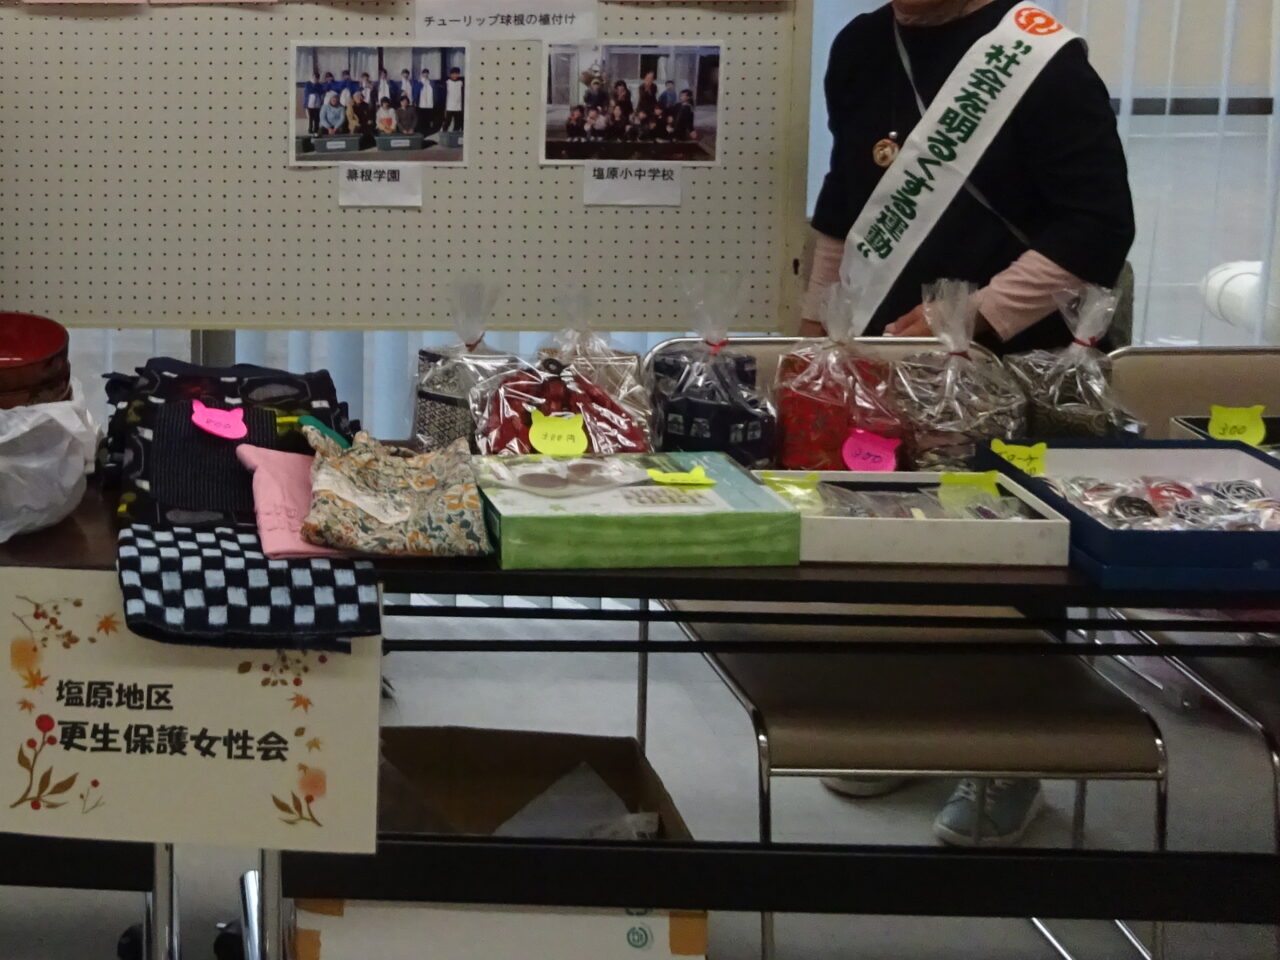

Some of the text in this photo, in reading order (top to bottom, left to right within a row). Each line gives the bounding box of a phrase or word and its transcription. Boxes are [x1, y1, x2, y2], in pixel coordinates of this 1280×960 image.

[423, 12, 577, 27] チューリップ球根の植付け
[591, 167, 675, 181] 塩原小中学校
[56, 679, 174, 711] 塩原地区
[57, 720, 290, 762] 更生保護女性会
